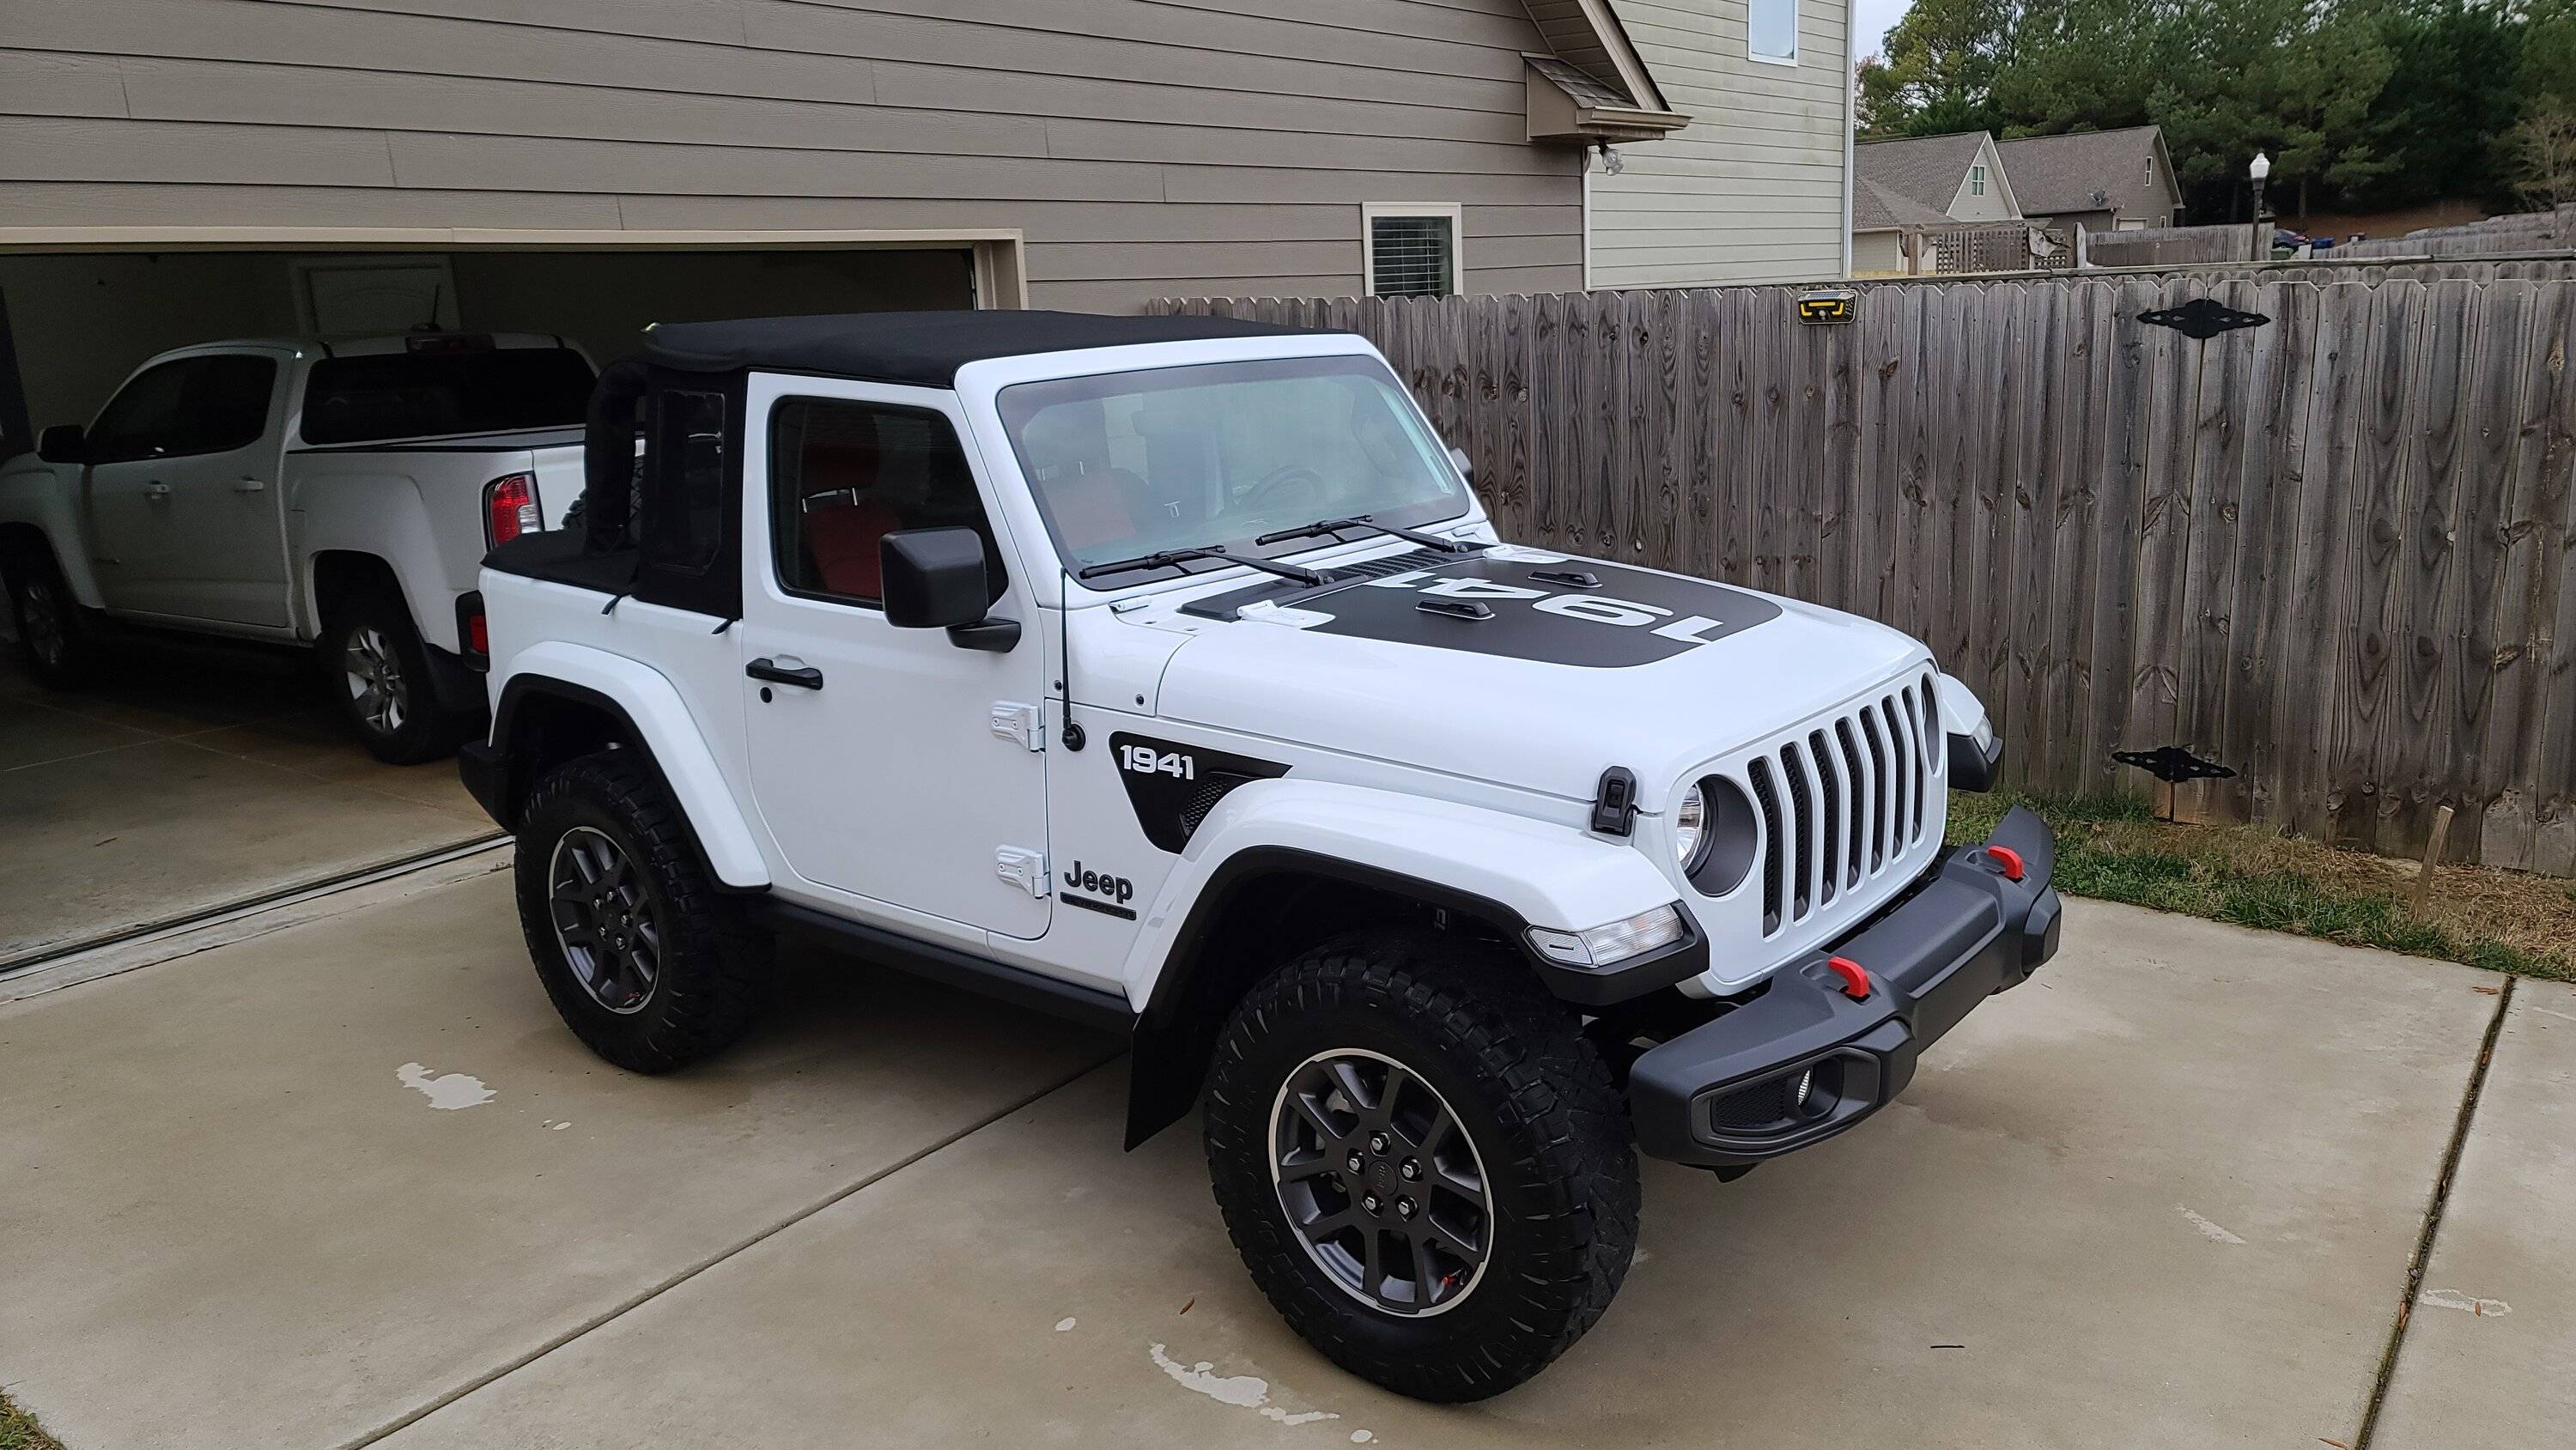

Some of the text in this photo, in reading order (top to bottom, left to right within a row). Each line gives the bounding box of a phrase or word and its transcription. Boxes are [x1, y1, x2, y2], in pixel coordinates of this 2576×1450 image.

[1364, 570, 1723, 644] 1941
[1120, 744, 1194, 780] 1941
[1063, 859, 1133, 905] Jeep
